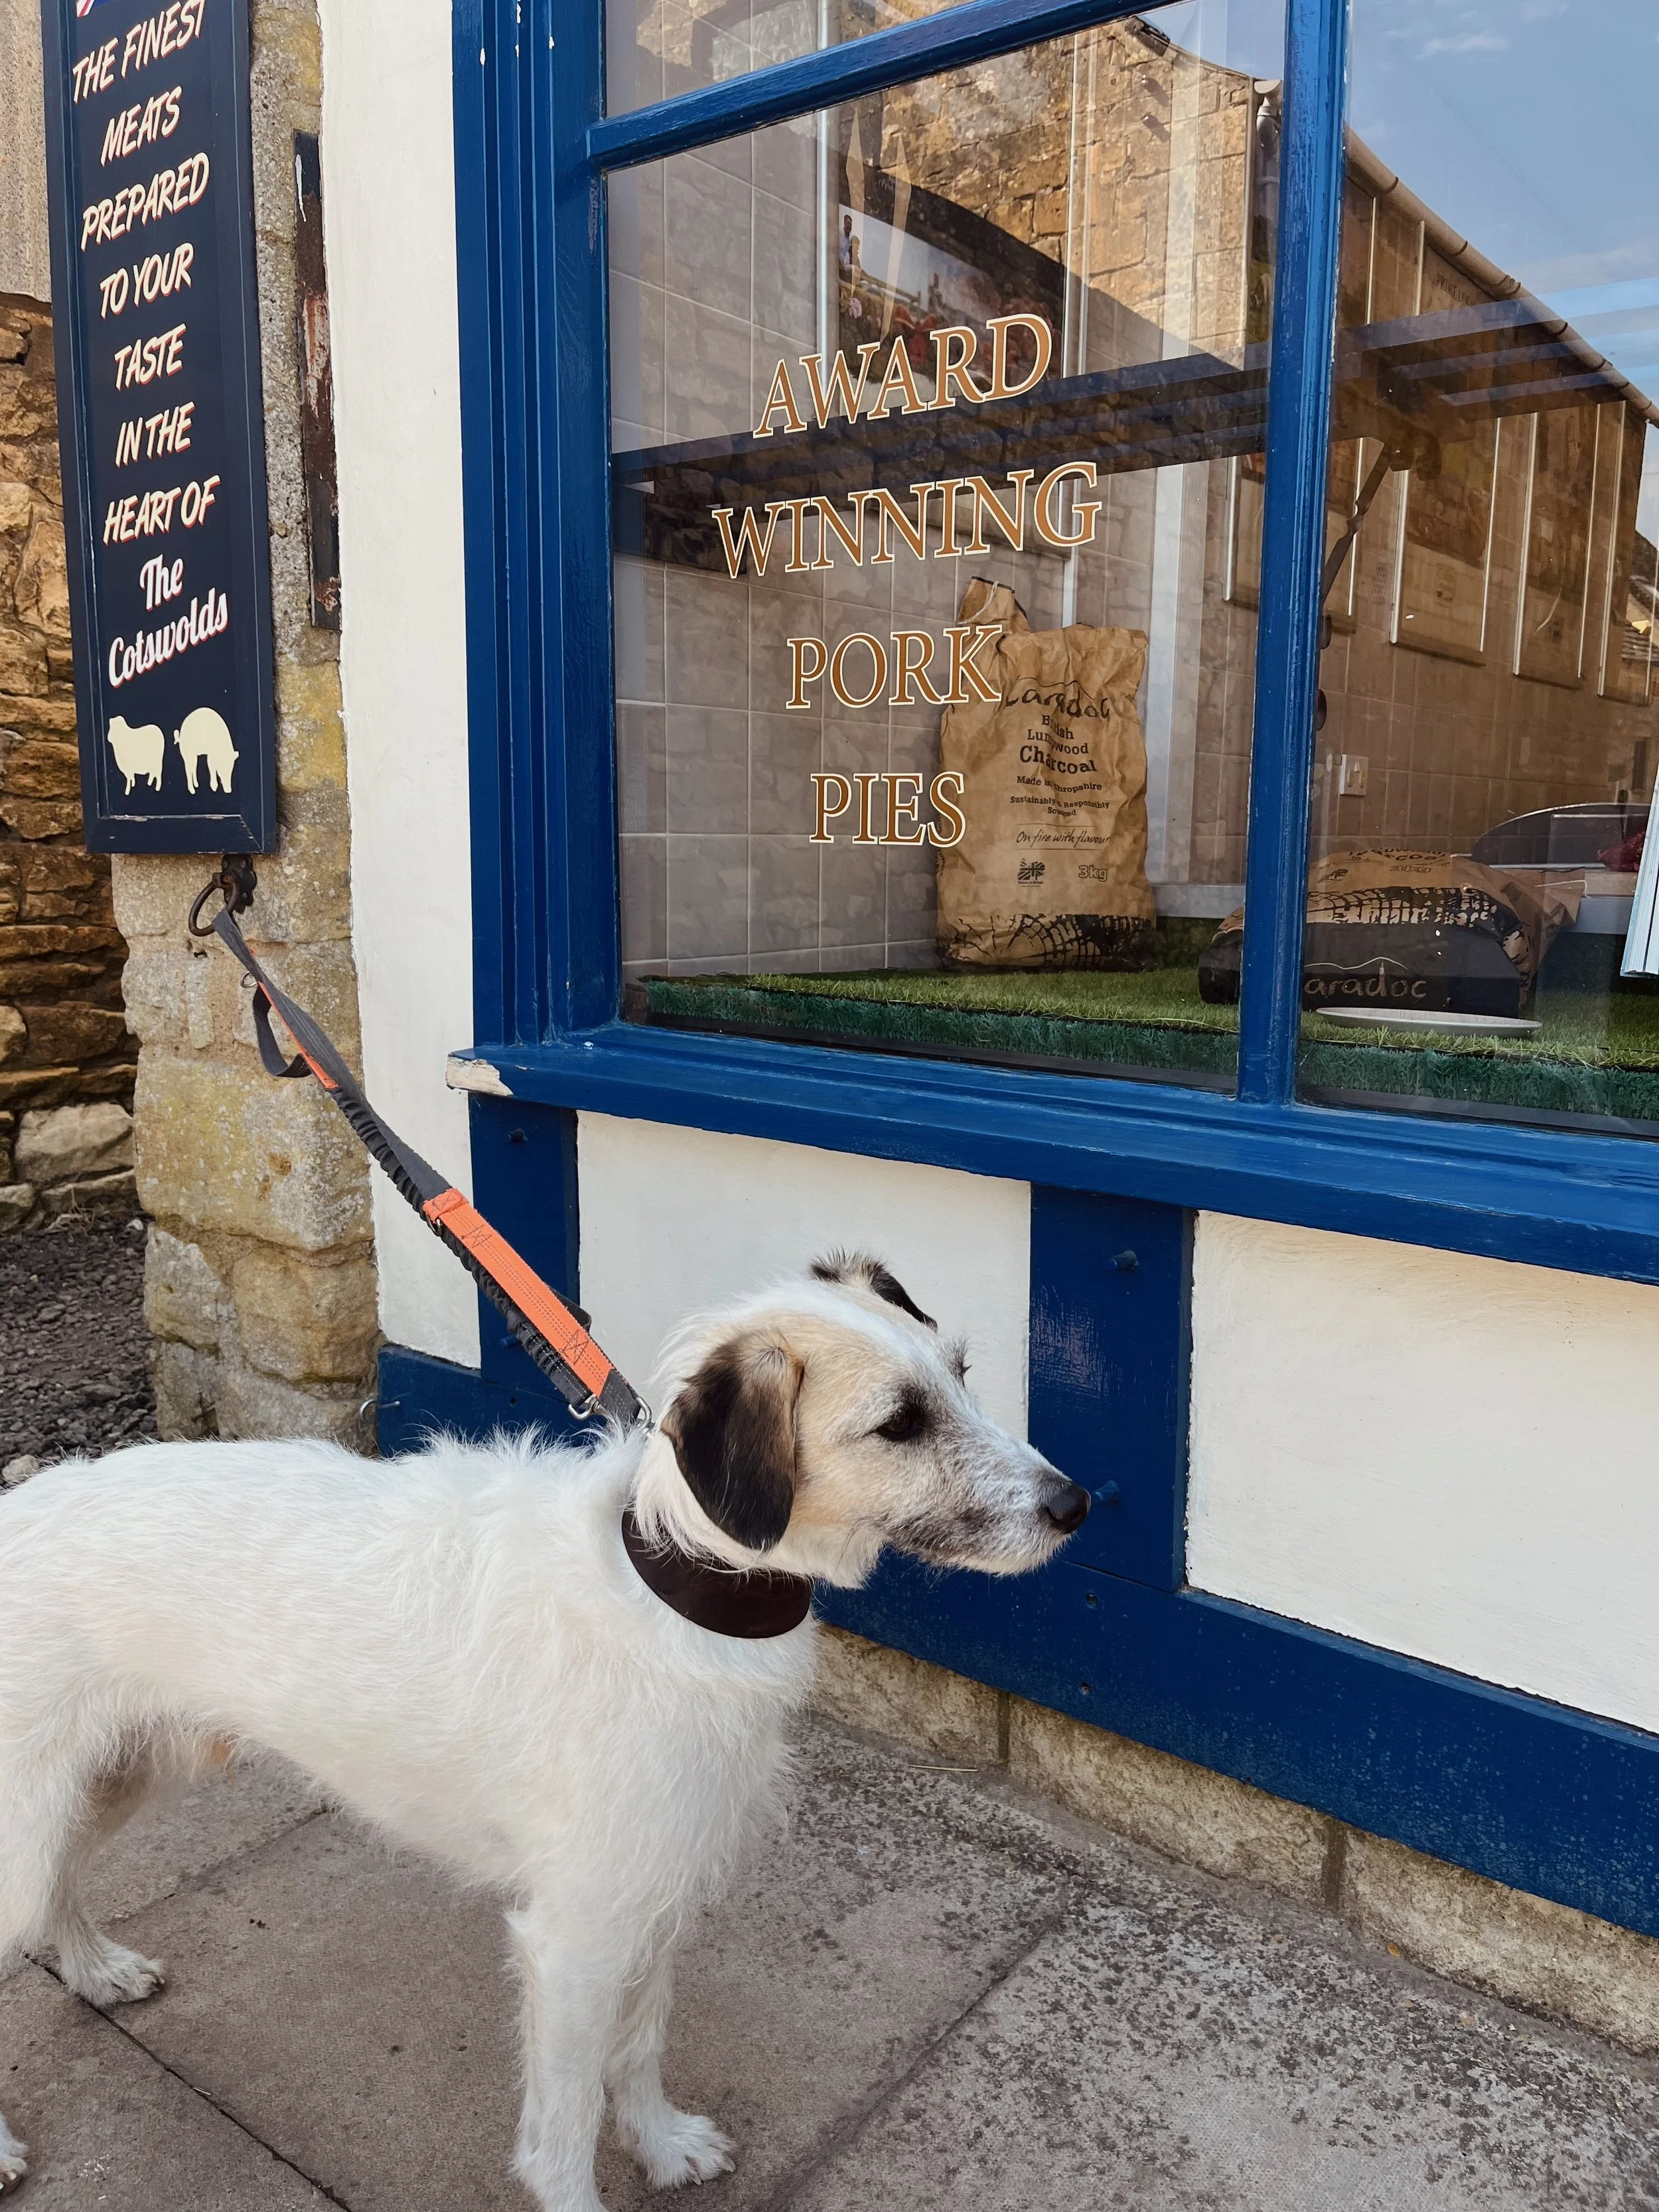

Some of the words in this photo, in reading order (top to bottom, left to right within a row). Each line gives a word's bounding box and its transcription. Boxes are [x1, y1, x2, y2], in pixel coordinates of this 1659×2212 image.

[72, 37, 119, 105] THE
[121, 0, 206, 79] FINEST
[100, 86, 182, 167] MEATS
[80, 152, 210, 252] PREPARED
[100, 267, 129, 319] TO
[133, 242, 194, 307] YOUR
[114, 323, 186, 391] TASTE
[753, 313, 1052, 439] AWARD
[115, 418, 145, 468] IN
[145, 402, 196, 459] THE
[103, 488, 181, 546] HEART
[180, 475, 220, 529] OF
[711, 461, 1103, 579] WINNING
[139, 554, 184, 611] The
[107, 588, 228, 688] Cotswolds
[786, 624, 1003, 709] PORK
[1017, 776, 1041, 786] Made
[1045, 778, 1053, 787] in
[1020, 745, 1098, 774] Charcoal
[809, 771, 966, 848] PIES
[1010, 796, 1056, 805] Sustainably
[1064, 800, 1110, 809] Responsibly
[1016, 831, 1030, 843] On
[1030, 830, 1050, 848] fire
[1052, 829, 1074, 842] with
[1074, 830, 1110, 848] flavour
[1078, 865, 1108, 882] 3kg
[1304, 962, 1426, 999] aradoc
